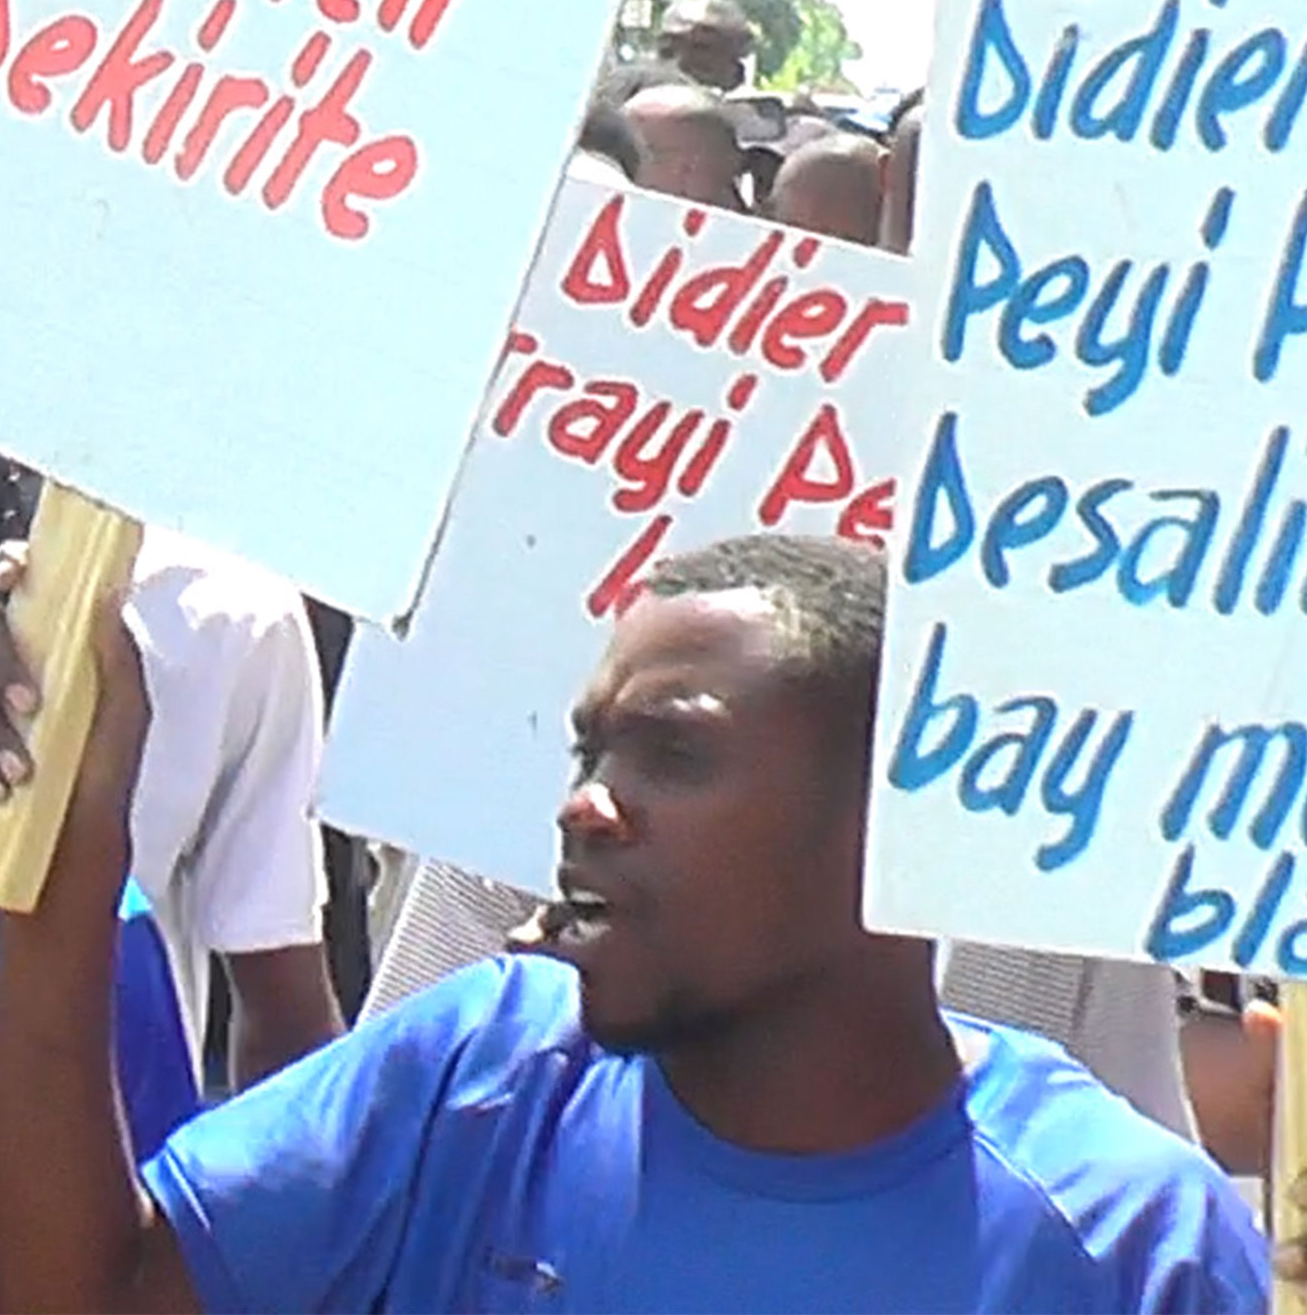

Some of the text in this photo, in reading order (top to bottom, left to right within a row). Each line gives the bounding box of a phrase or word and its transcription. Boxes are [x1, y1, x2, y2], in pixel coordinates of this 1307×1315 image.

[561, 194, 909, 383] Didier
[940, 179, 1235, 419] Peyi
[492, 330, 758, 512] rayi
[902, 408, 1307, 619] Desali
[885, 620, 1135, 873] bay
